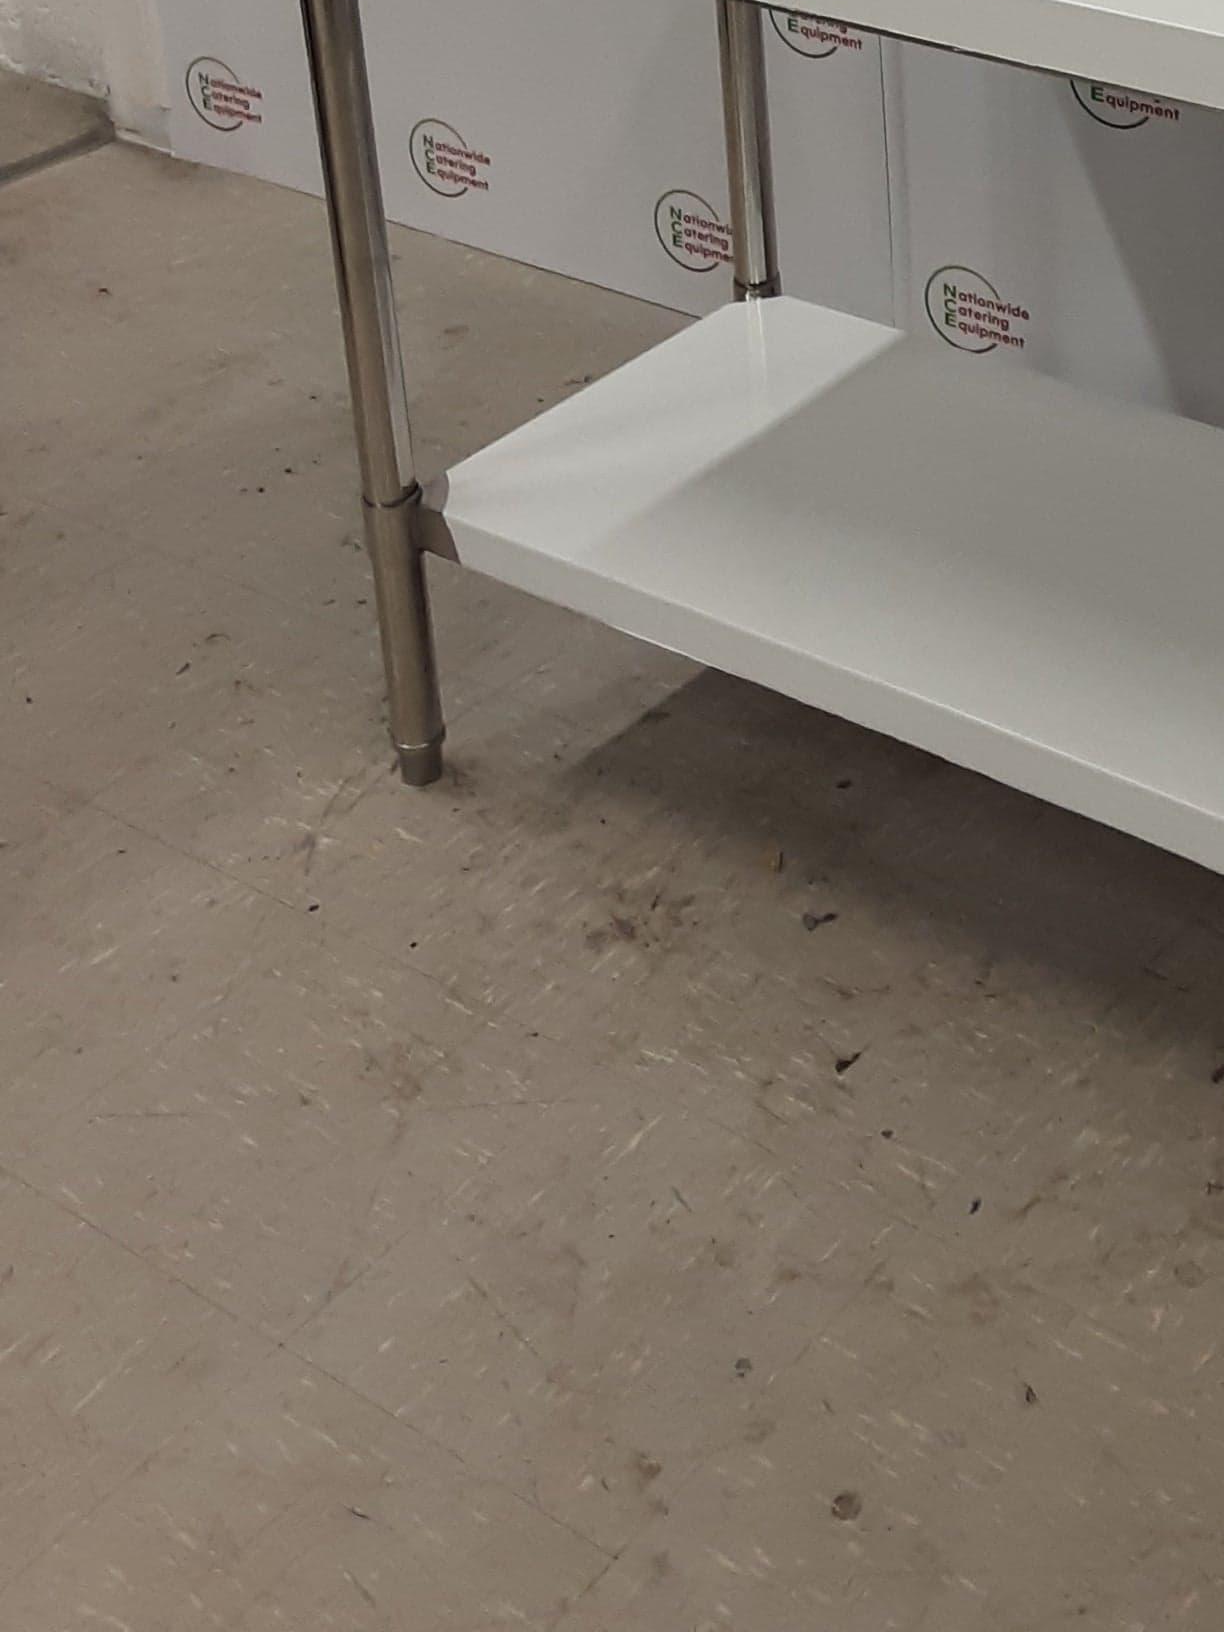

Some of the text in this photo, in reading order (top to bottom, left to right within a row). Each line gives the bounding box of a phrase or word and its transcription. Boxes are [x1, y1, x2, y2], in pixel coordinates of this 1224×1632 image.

[787, 17, 863, 51] Equipment
[1091, 86, 1180, 120] Equipment
[423, 134, 491, 166] Nationwide
[425, 149, 476, 177] Catering
[426, 161, 489, 190] Equipment
[671, 220, 729, 251] Catering
[672, 233, 734, 263] Equipme
[943, 283, 1029, 320] Nationwide
[944, 299, 1009, 331] Catering
[945, 312, 1024, 348] Equipment
